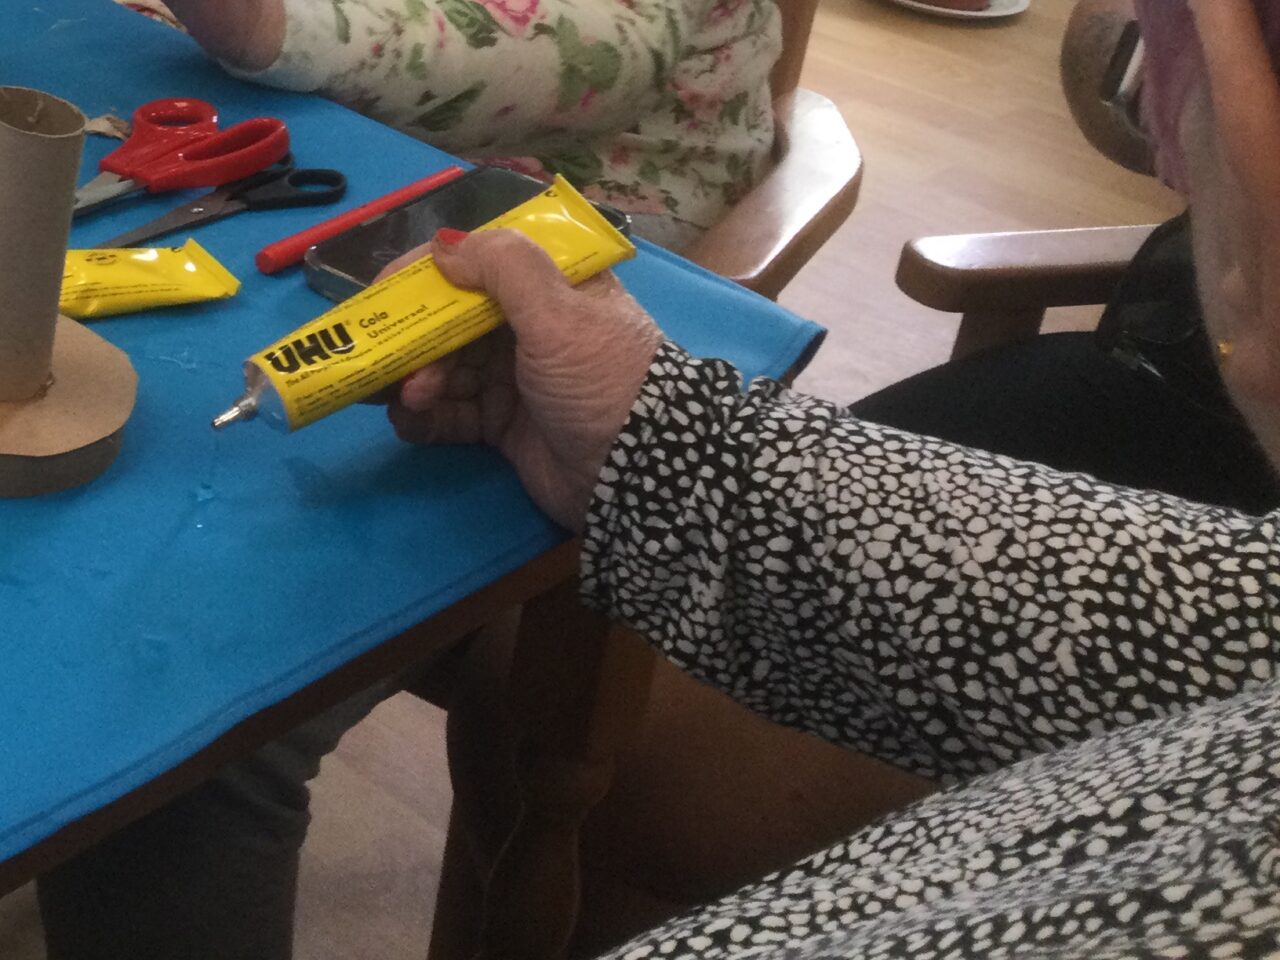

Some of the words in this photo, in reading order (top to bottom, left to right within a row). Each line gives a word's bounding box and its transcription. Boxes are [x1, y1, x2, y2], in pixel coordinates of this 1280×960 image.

[359, 311, 389, 329] Cola
[366, 304, 428, 339] Universal
[263, 321, 356, 374] UHU
